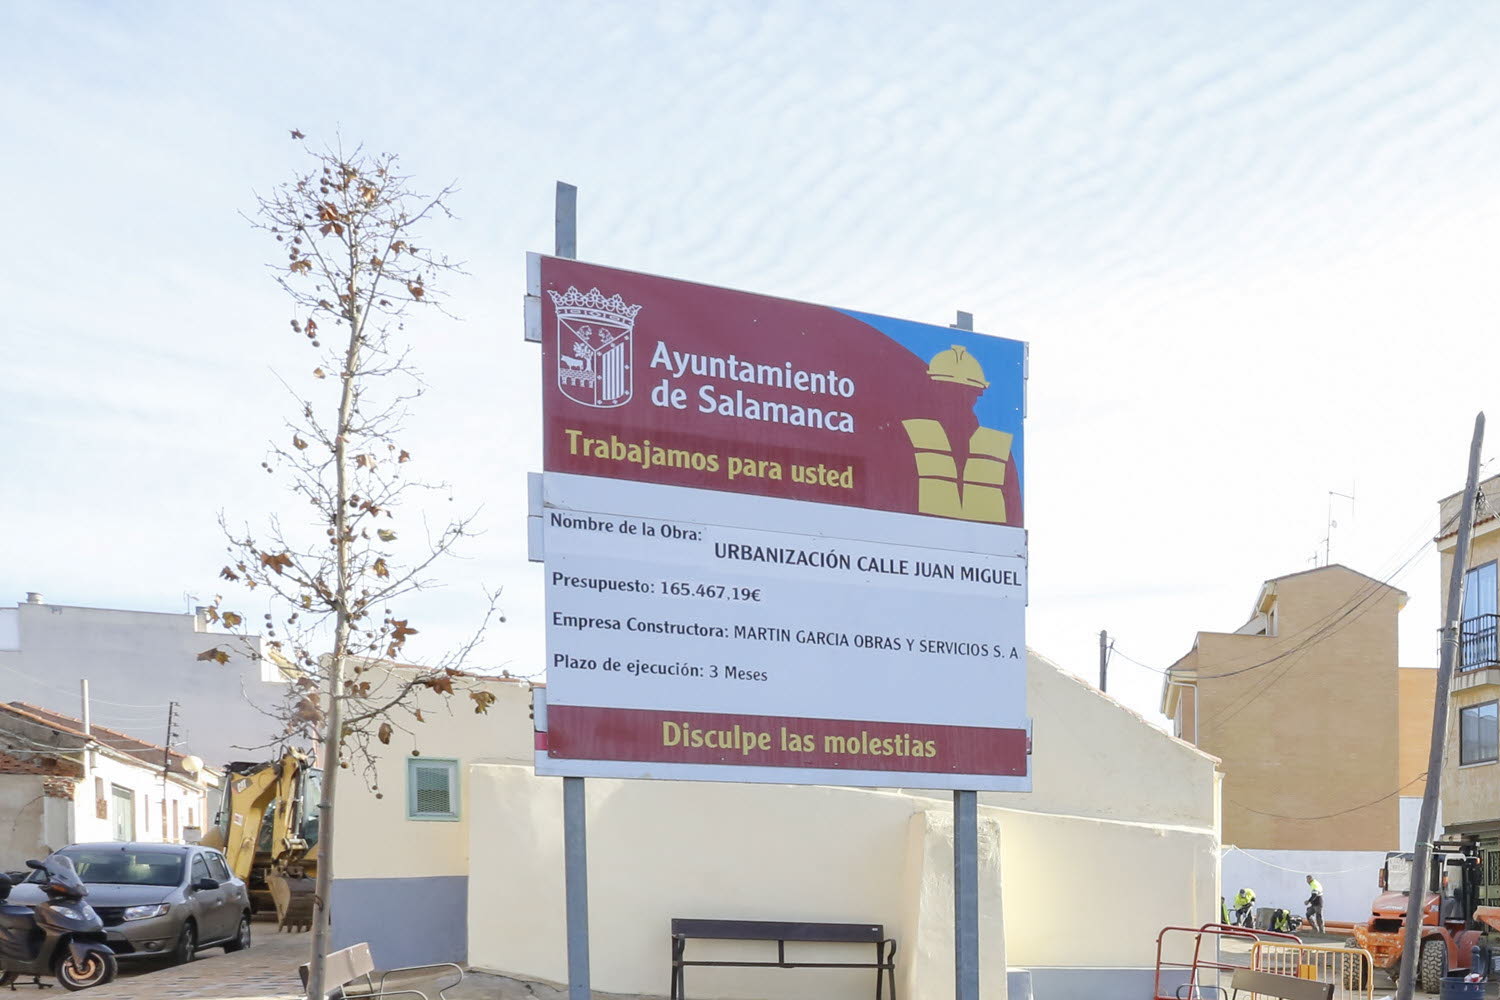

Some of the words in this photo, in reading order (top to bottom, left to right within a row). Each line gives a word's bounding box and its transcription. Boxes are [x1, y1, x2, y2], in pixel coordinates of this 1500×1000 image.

[649, 341, 855, 398] Ayuntamiento
[651, 378, 687, 410] de
[698, 384, 856, 433] Salamanca
[565, 429, 720, 473] Trabajamos
[728, 455, 782, 480] para
[791, 464, 853, 489] usted
[550, 512, 614, 533] Nombre
[619, 520, 637, 535] de
[642, 522, 656, 537] la
[660, 524, 702, 541] Obra:
[552, 571, 655, 594] Presupuesto:
[714, 542, 851, 570] URBANIZACIÓN
[857, 556, 909, 575] CALLE
[913, 561, 955, 580] JUAN
[960, 567, 1022, 587] MIGUEL
[553, 611, 621, 631] Empresa
[626, 617, 729, 639] Constructora:
[734, 625, 791, 642] MARTIN
[796, 630, 849, 647] GARCIA
[853, 634, 901, 651] OBRAS
[906, 638, 915, 652] Y
[919, 639, 989, 657] SERVICIOS
[993, 645, 1005, 659] S.
[553, 653, 597, 670] Plazo
[602, 657, 621, 672] de
[626, 659, 704, 677] ejecución:
[709, 664, 718, 678] 3
[724, 665, 768, 682] Meses
[662, 721, 771, 755] Disculpe
[780, 726, 815, 753] las
[824, 731, 937, 758] molestias
